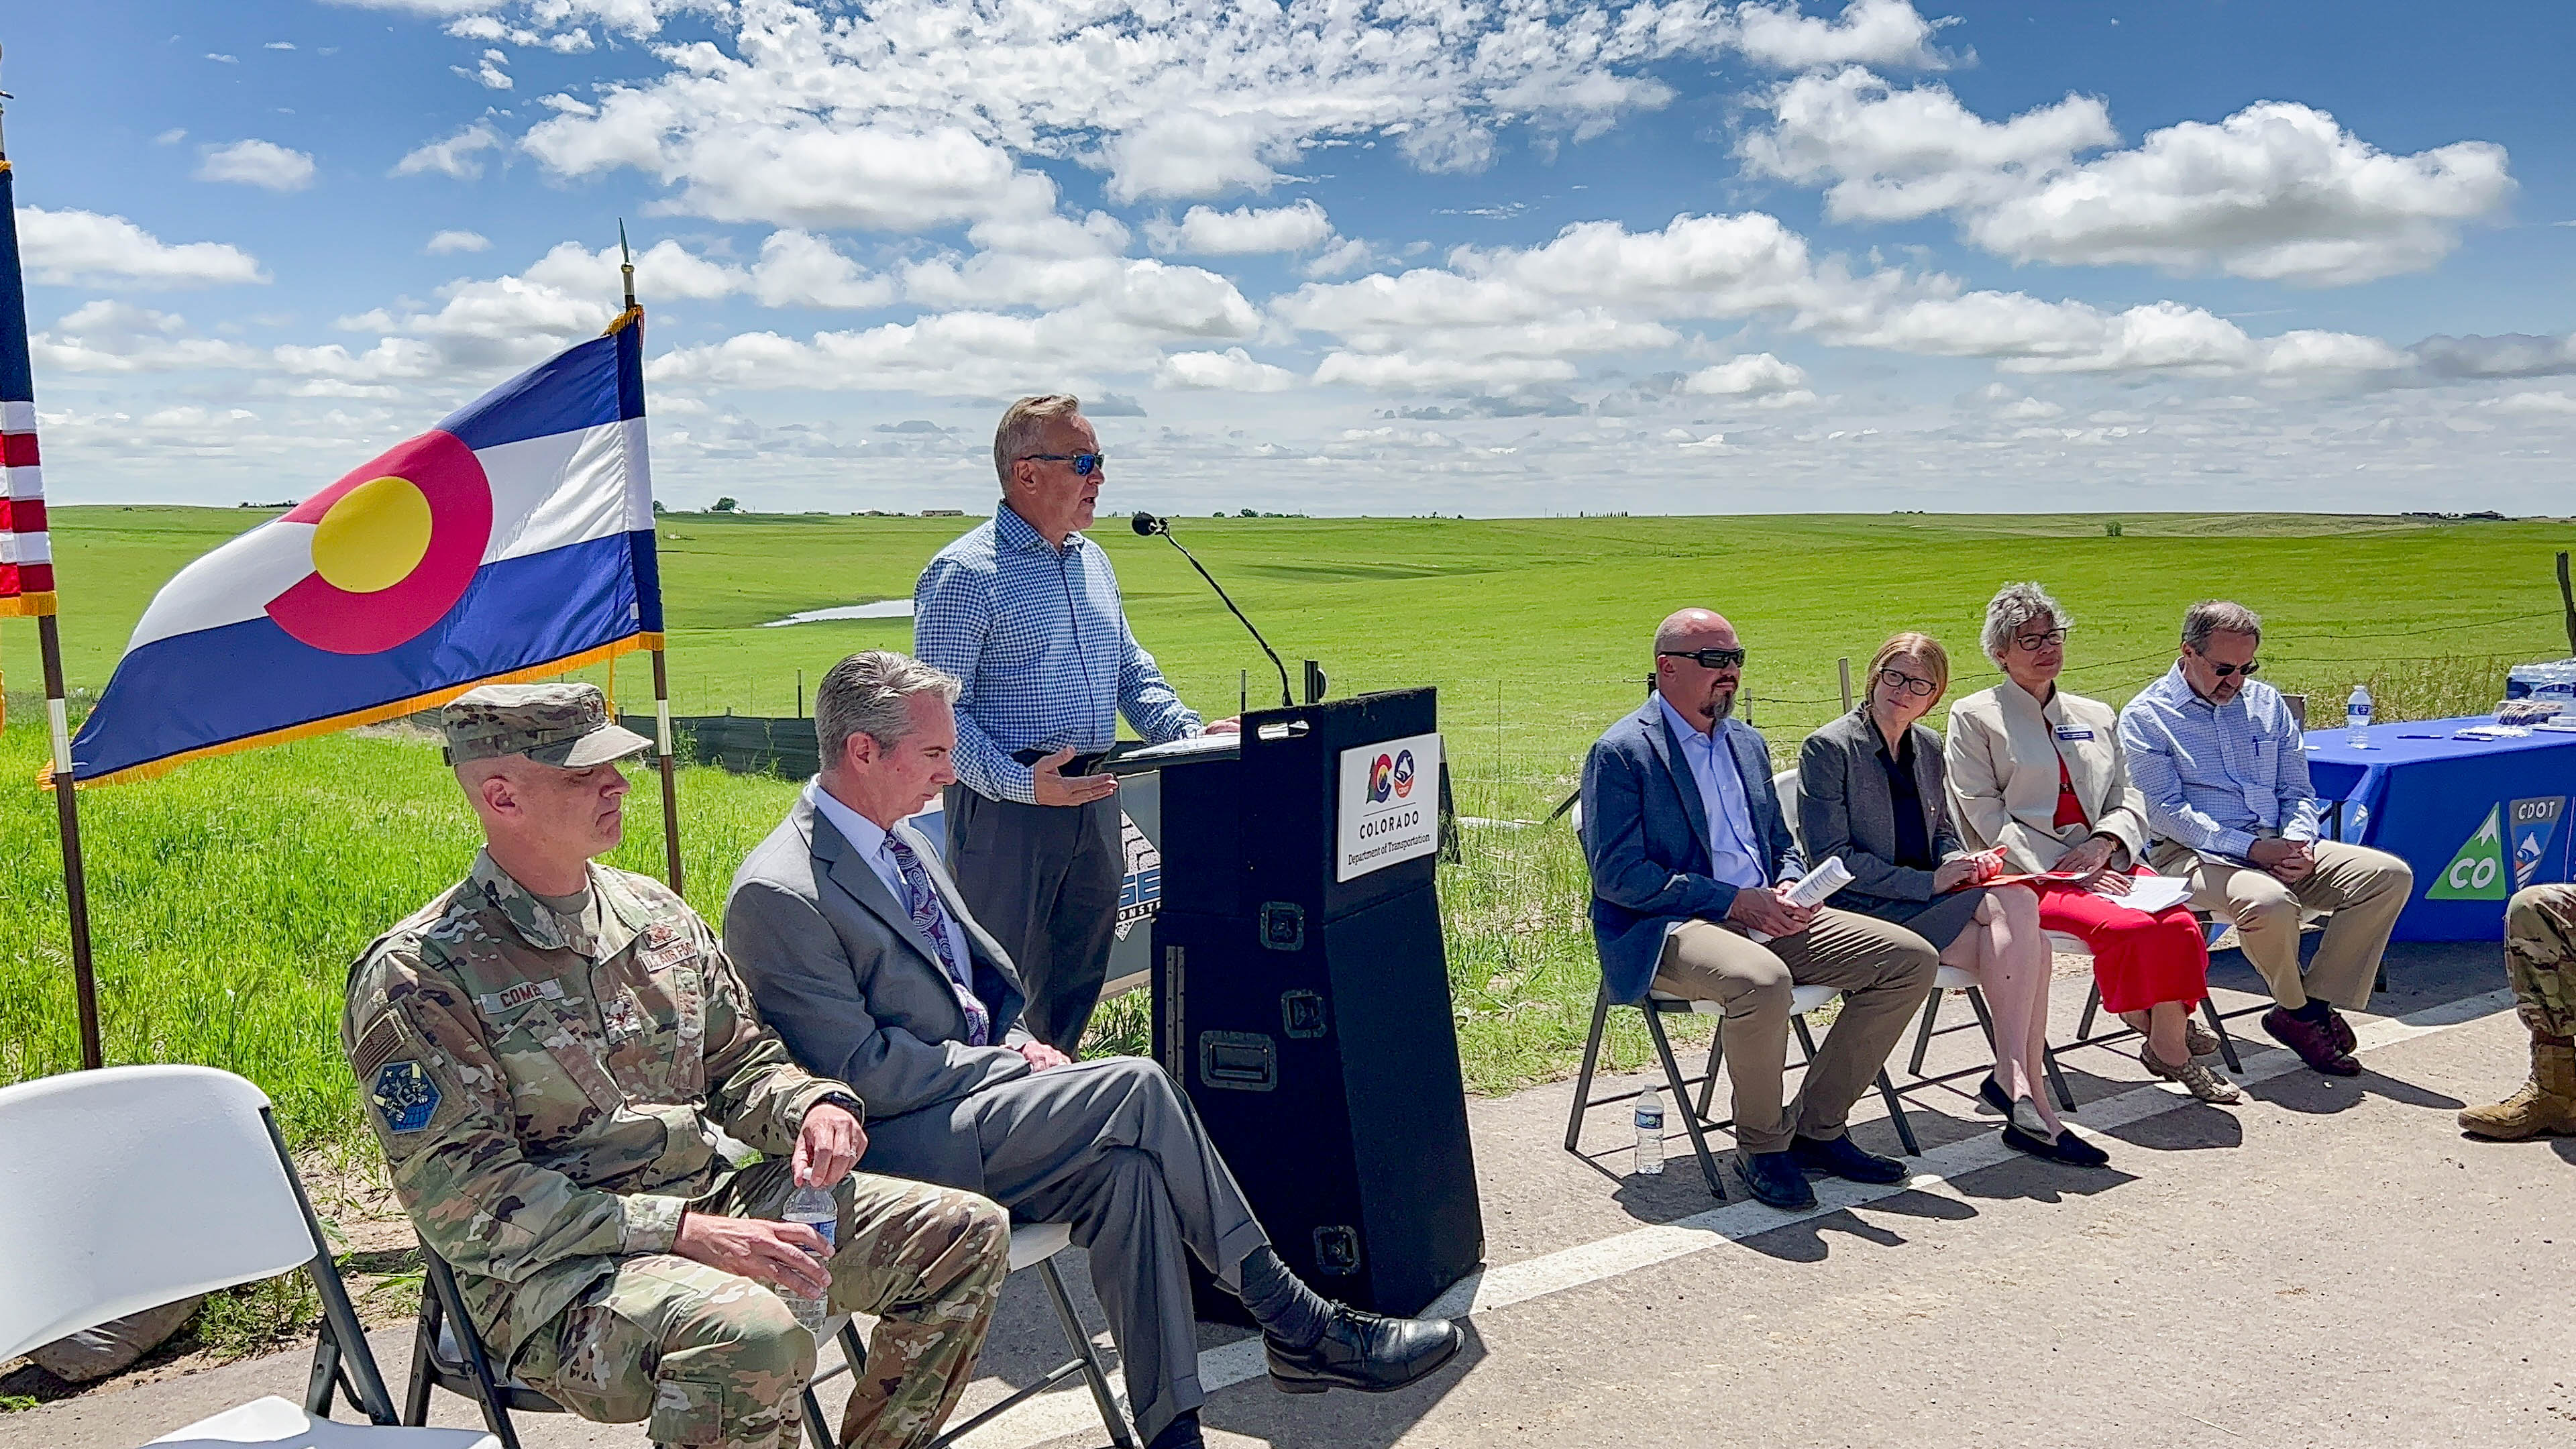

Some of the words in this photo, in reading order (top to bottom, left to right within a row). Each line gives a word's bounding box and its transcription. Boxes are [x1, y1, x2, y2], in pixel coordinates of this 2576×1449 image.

[1360, 810, 1419, 839] COLORADO
[2518, 801, 2555, 820] CDOT
[1348, 846, 1381, 865] Department
[1381, 843, 1387, 854] of
[1388, 833, 1430, 851] Transportation
[2449, 857, 2496, 889] CO
